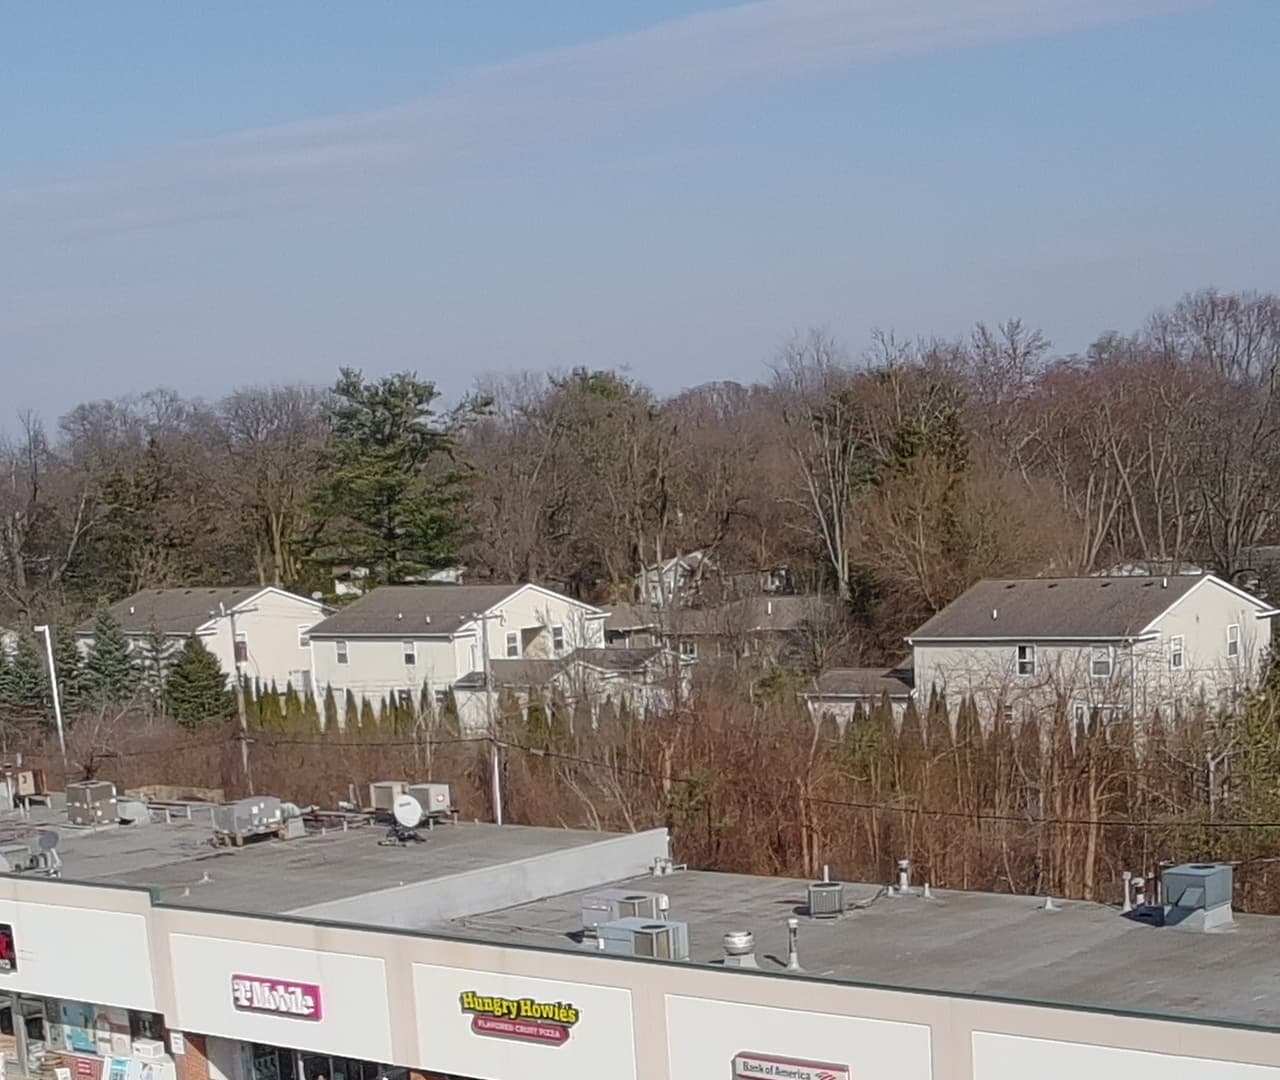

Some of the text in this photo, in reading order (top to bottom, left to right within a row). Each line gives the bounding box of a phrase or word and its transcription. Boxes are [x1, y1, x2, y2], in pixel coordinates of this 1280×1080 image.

[462, 992, 577, 1022] Hungry Howie's
[539, 1028, 560, 1038] PIZZA
[743, 1061, 811, 1080] Bank of America
